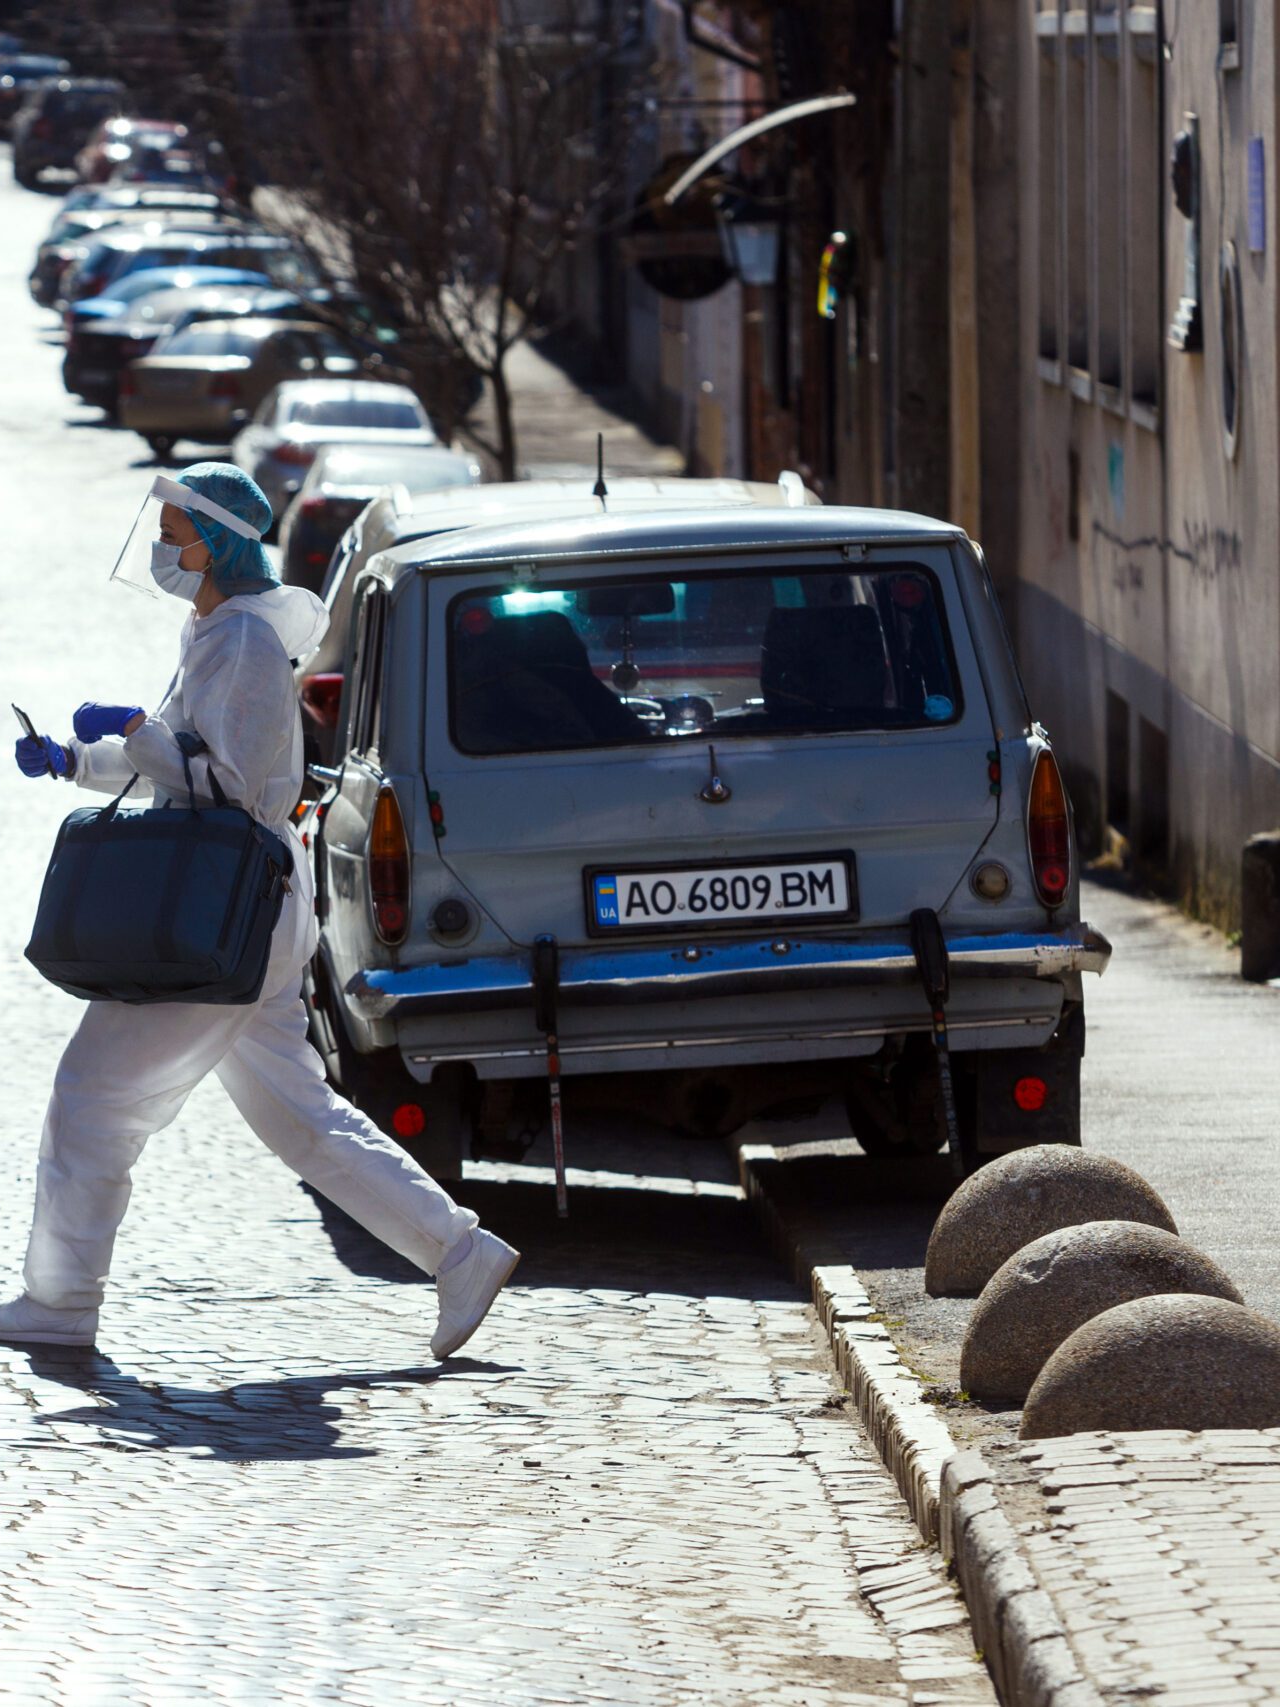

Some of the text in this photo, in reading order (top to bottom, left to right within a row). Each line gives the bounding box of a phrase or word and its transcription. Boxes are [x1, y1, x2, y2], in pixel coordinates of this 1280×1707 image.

[625, 869, 836, 917] AO 6809 BM
[600, 907, 617, 919] UA
